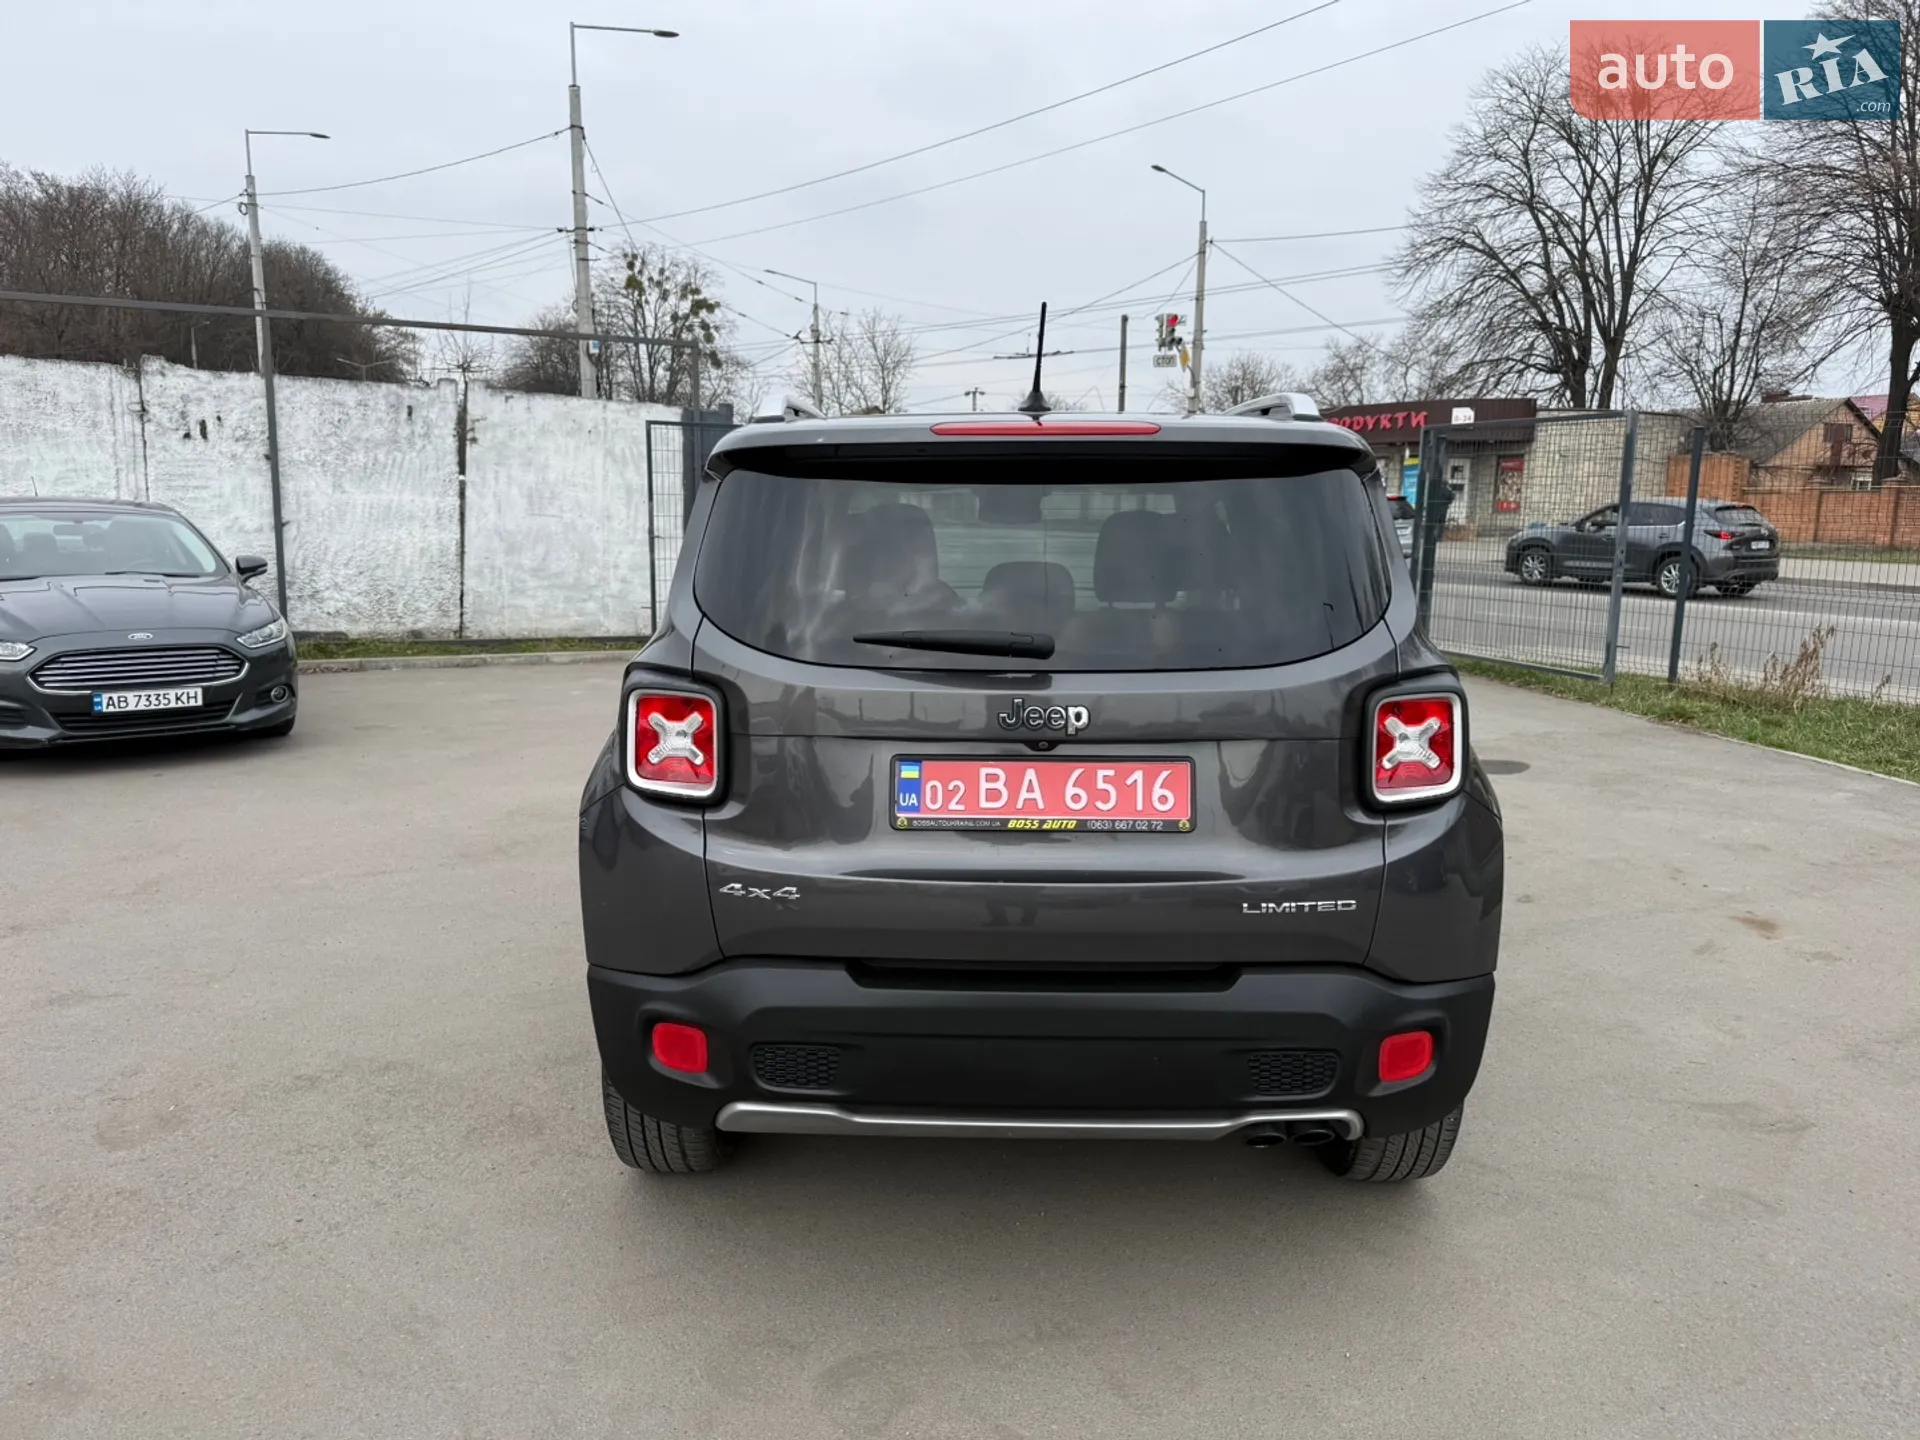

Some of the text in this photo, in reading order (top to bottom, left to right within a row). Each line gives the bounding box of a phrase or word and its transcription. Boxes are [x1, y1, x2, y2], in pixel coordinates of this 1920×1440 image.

[105, 691, 198, 710] AB 7335 KH
[998, 697, 1091, 736] Jeep
[925, 767, 1175, 812] 02 BA 6516
[899, 793, 918, 806] UA
[1007, 819, 1039, 829] BOSS
[1087, 820, 1112, 830] (063)
[1135, 821, 1148, 830] 02
[1150, 821, 1163, 830] 72
[718, 882, 801, 900] 4x4
[1242, 900, 1357, 914] LIMITED
